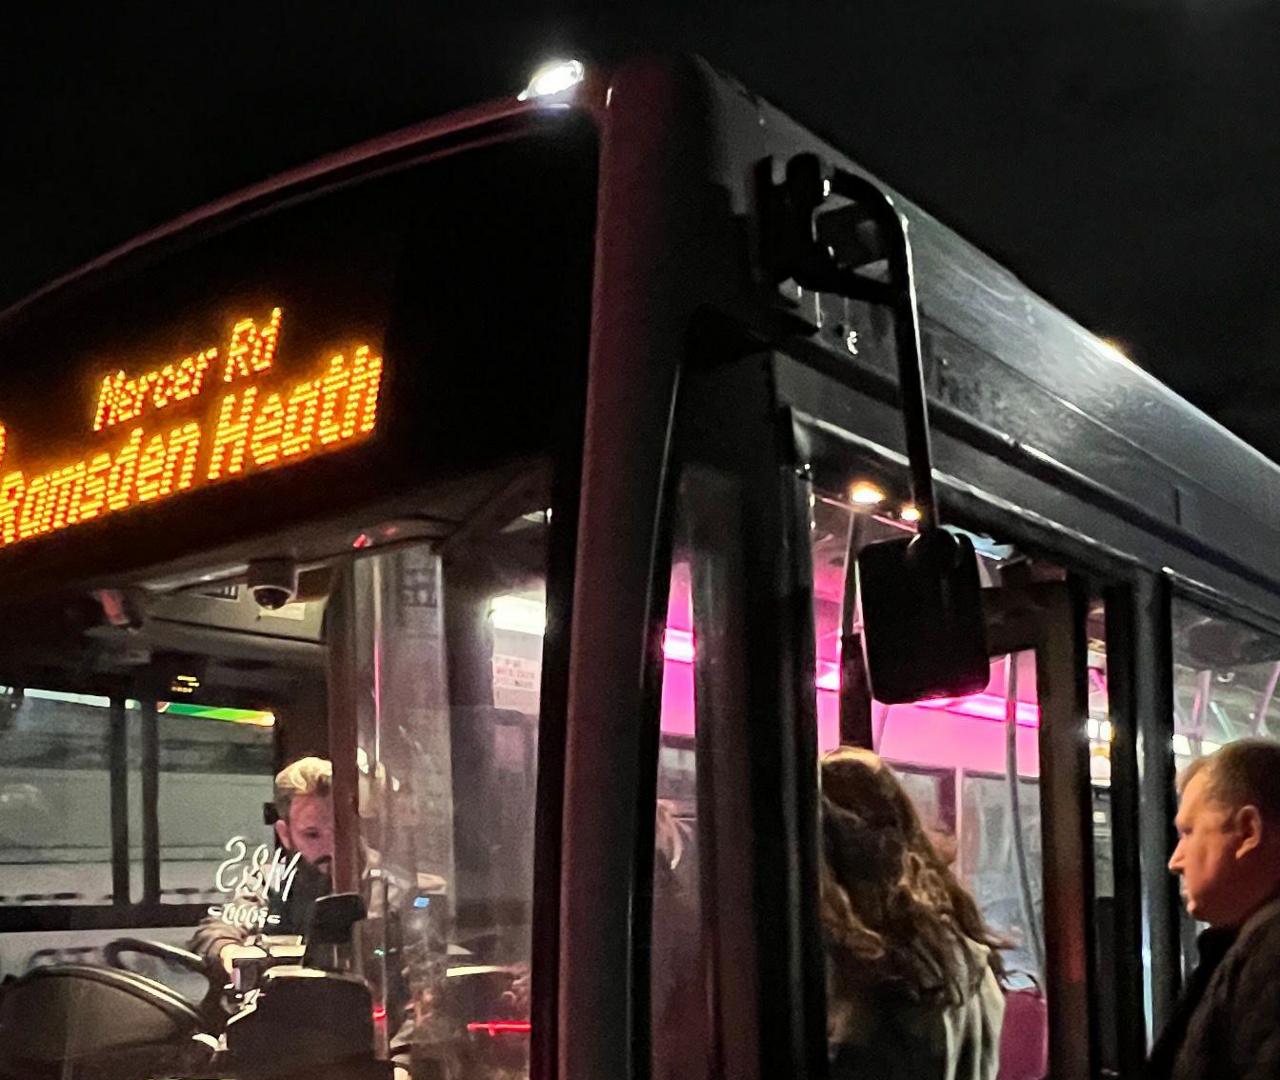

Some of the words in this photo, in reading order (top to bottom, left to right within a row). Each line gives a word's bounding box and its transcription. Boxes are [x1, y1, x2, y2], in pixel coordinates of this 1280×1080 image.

[93, 347, 217, 431] Mercer
[224, 307, 282, 382] Rd
[208, 344, 383, 480] Heath
